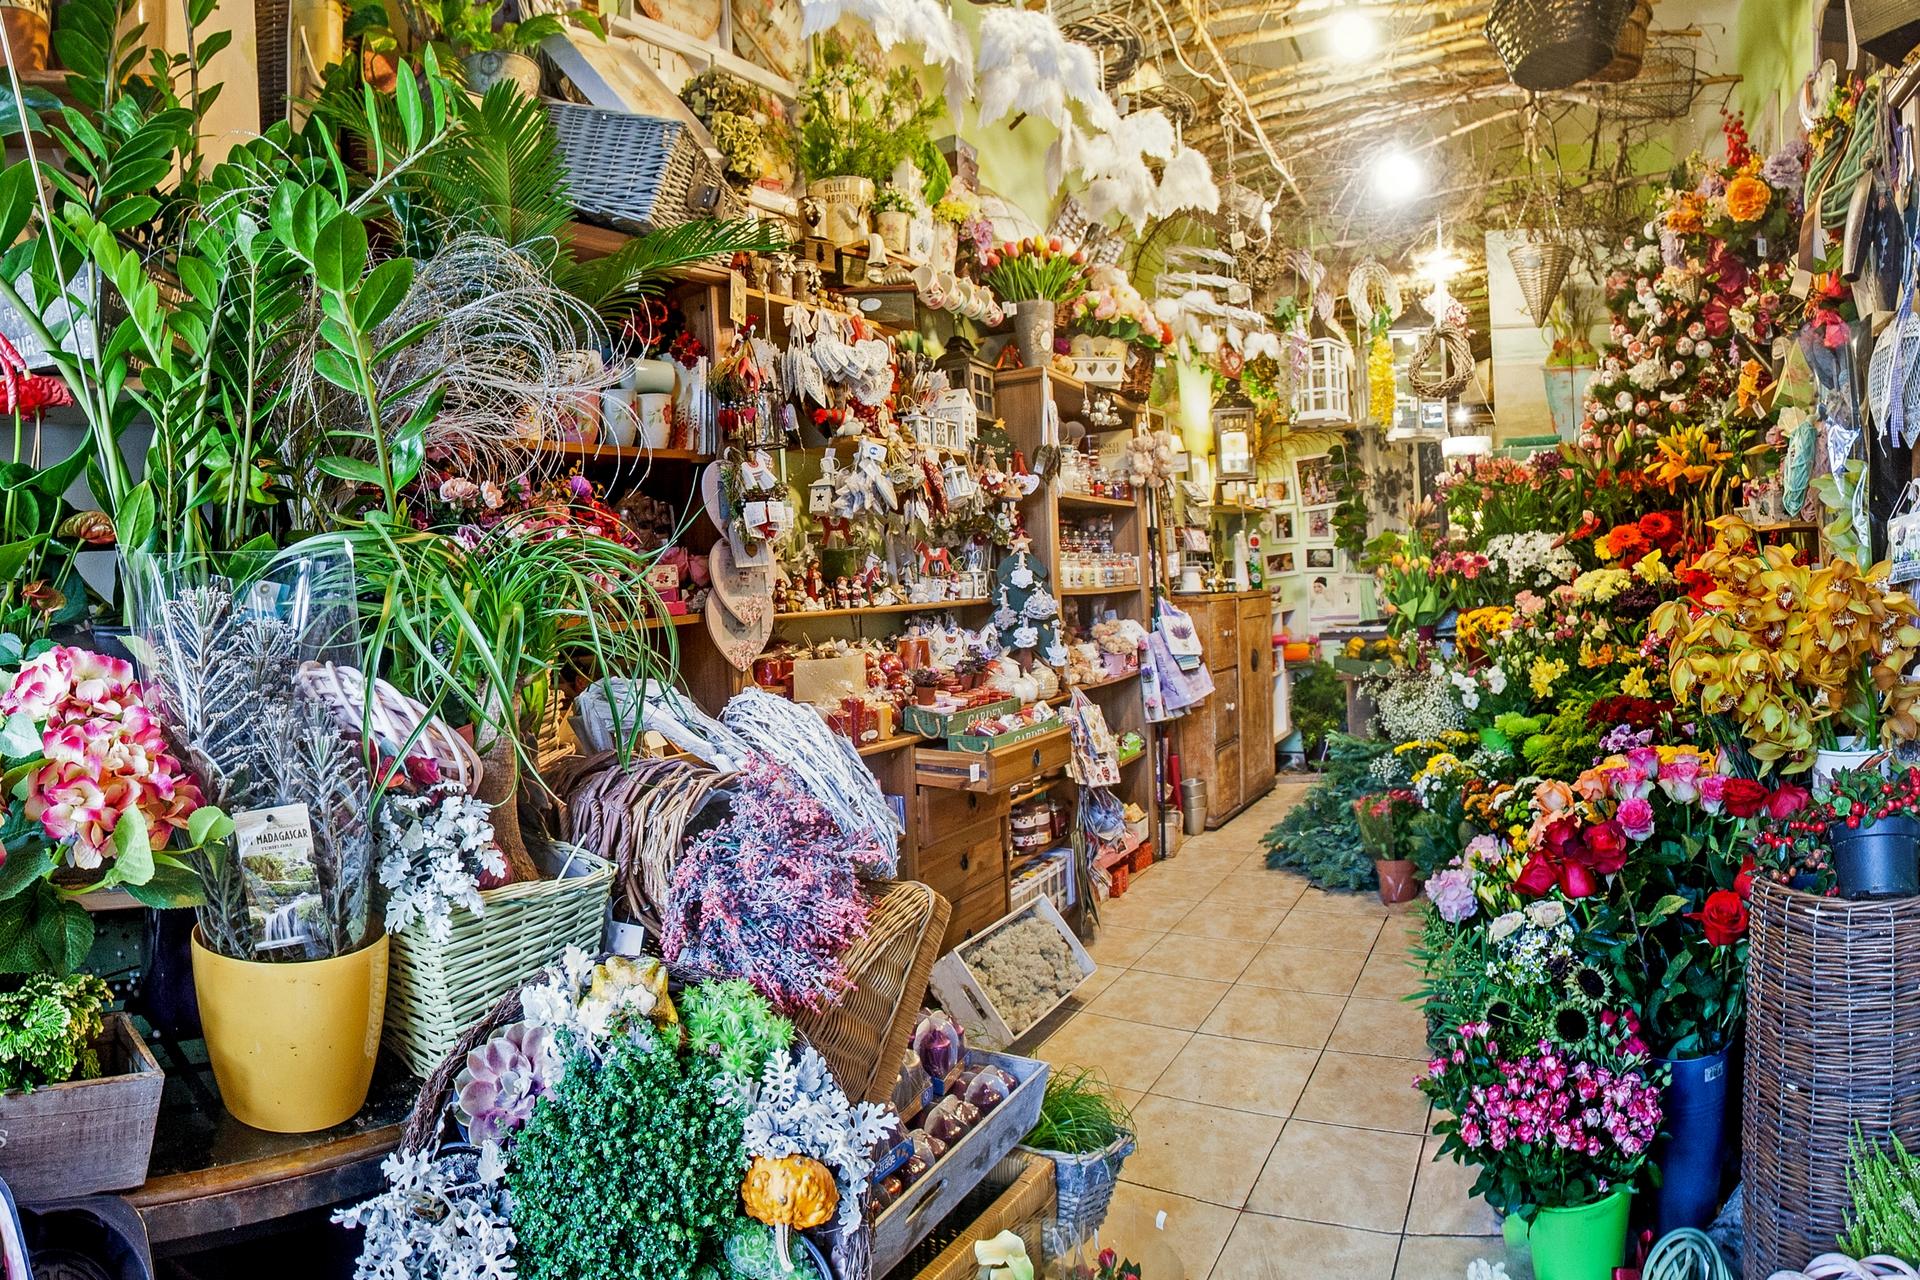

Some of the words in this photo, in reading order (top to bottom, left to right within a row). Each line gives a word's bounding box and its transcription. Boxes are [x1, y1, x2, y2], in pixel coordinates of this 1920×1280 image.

[824, 183, 847, 193] BELLE
[966, 707, 1004, 724] GARDEN
[1014, 727, 1048, 742] GARDEN
[256, 829, 308, 845] MADAGASCAR
